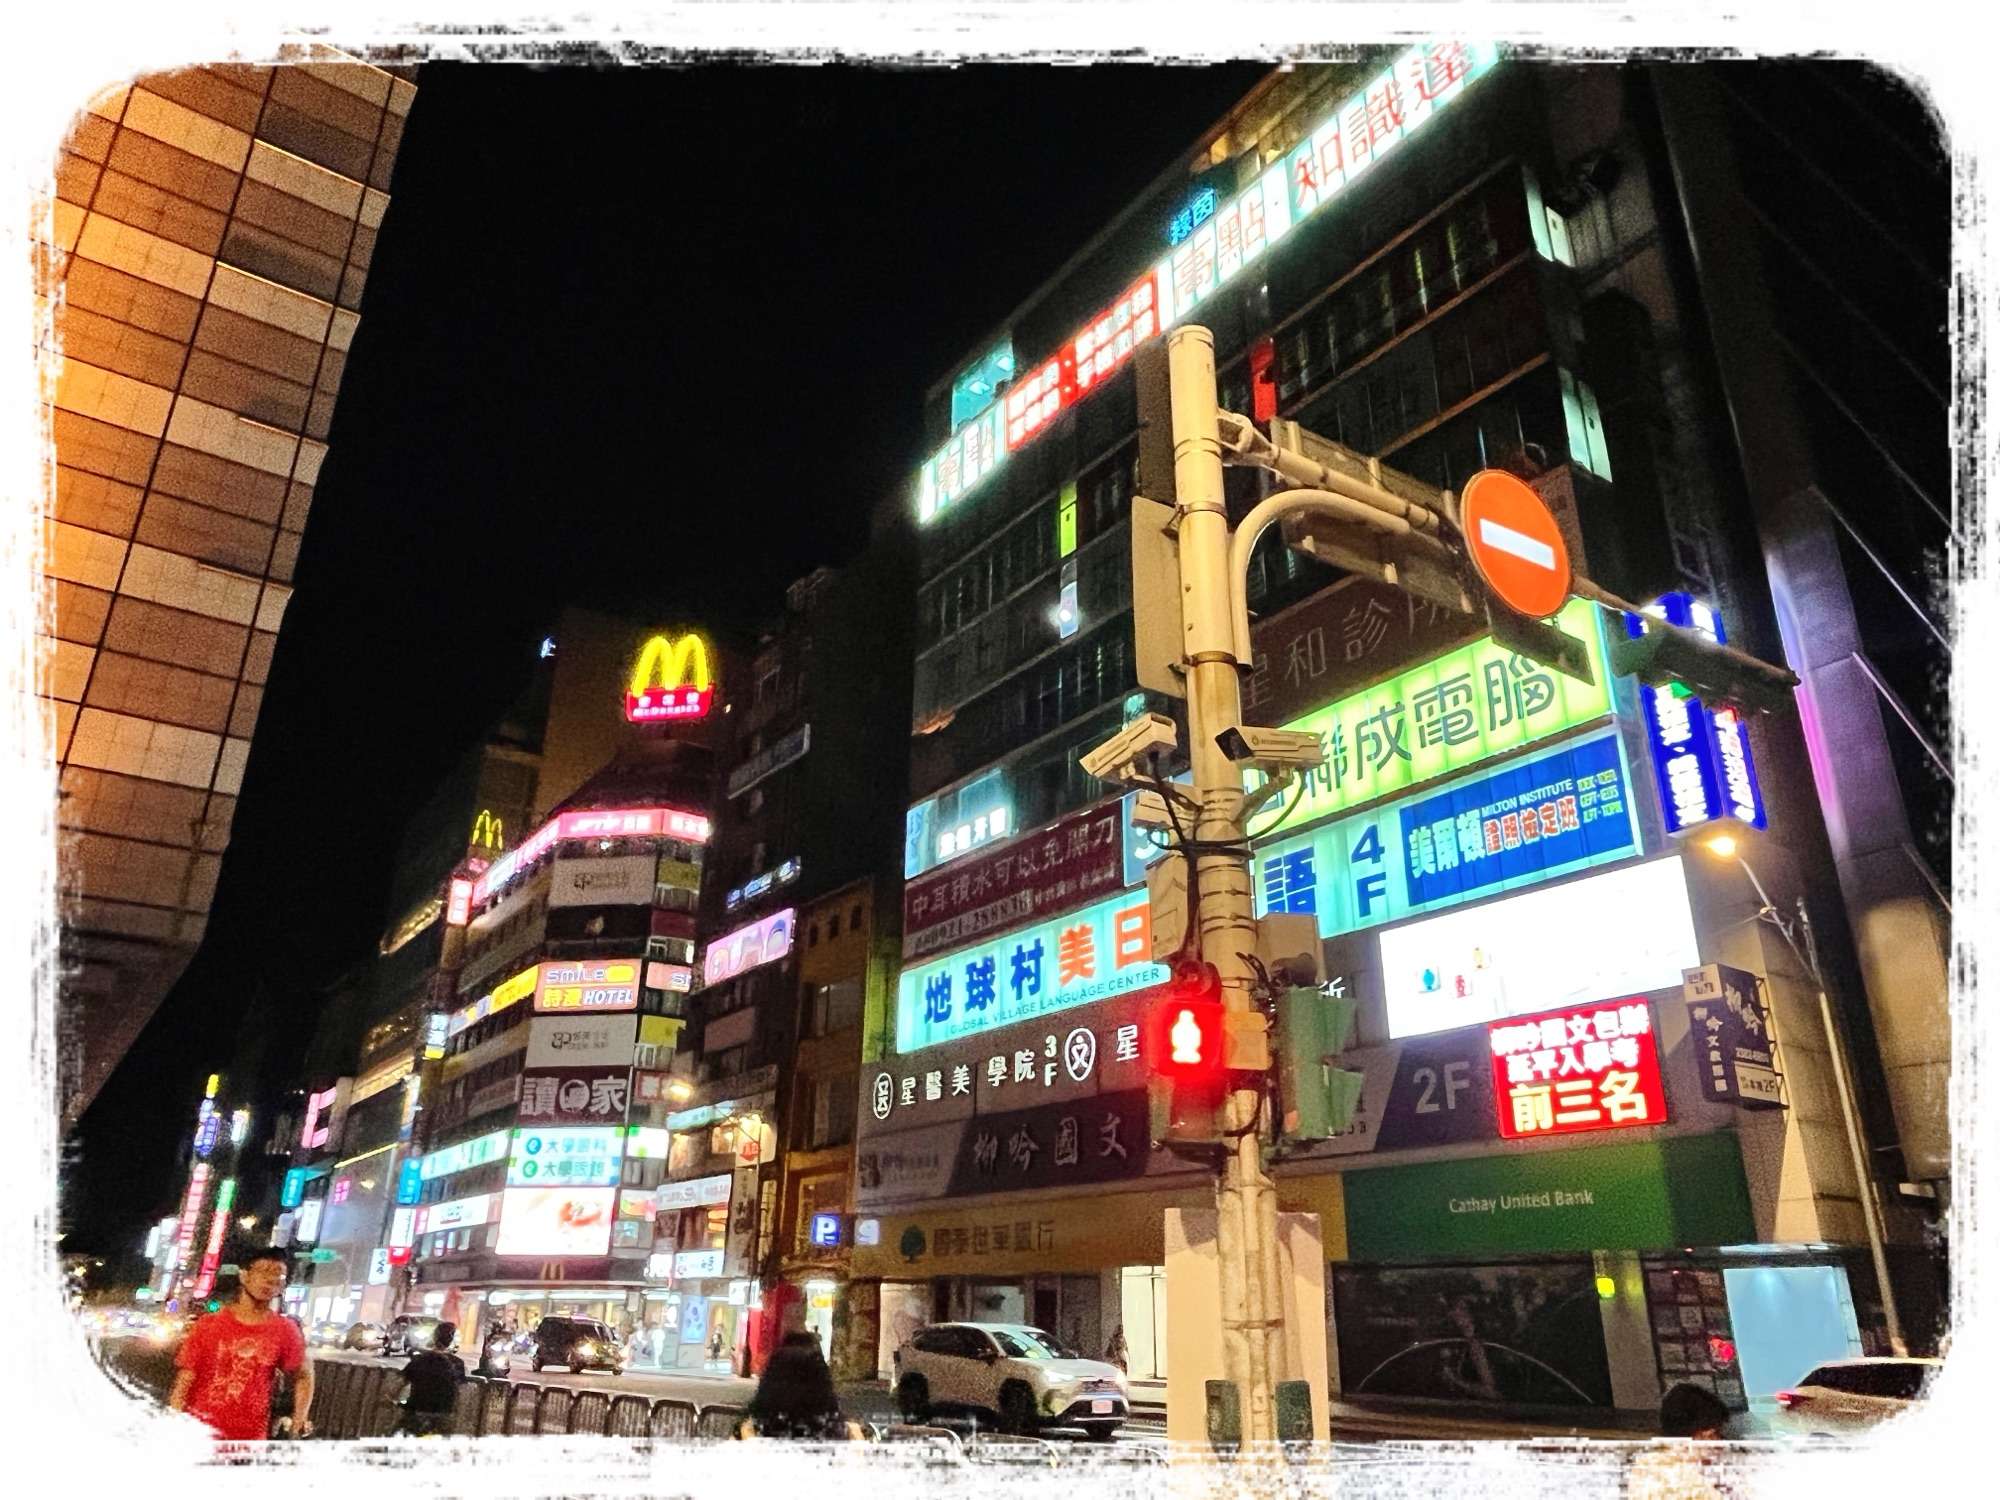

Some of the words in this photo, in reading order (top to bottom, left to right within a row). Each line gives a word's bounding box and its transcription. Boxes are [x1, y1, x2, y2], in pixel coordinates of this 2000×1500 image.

[1481, 797, 1518, 818] MILTON
[1519, 778, 1575, 807] INSTITUTE
[583, 987, 633, 1006] HOTEL
[992, 1002, 1037, 1022] VILLAGE
[1040, 984, 1105, 1011] LANGUAGE
[1108, 967, 1160, 991] CENTER
[900, 1049, 1036, 1106] 星醫美學院
[1413, 1060, 1471, 1114] 2F
[1509, 1070, 1648, 1133] 前三名
[1449, 1198, 1497, 1213] Cathay
[1502, 1194, 1551, 1209] United
[1555, 1190, 1595, 1207] Bank
